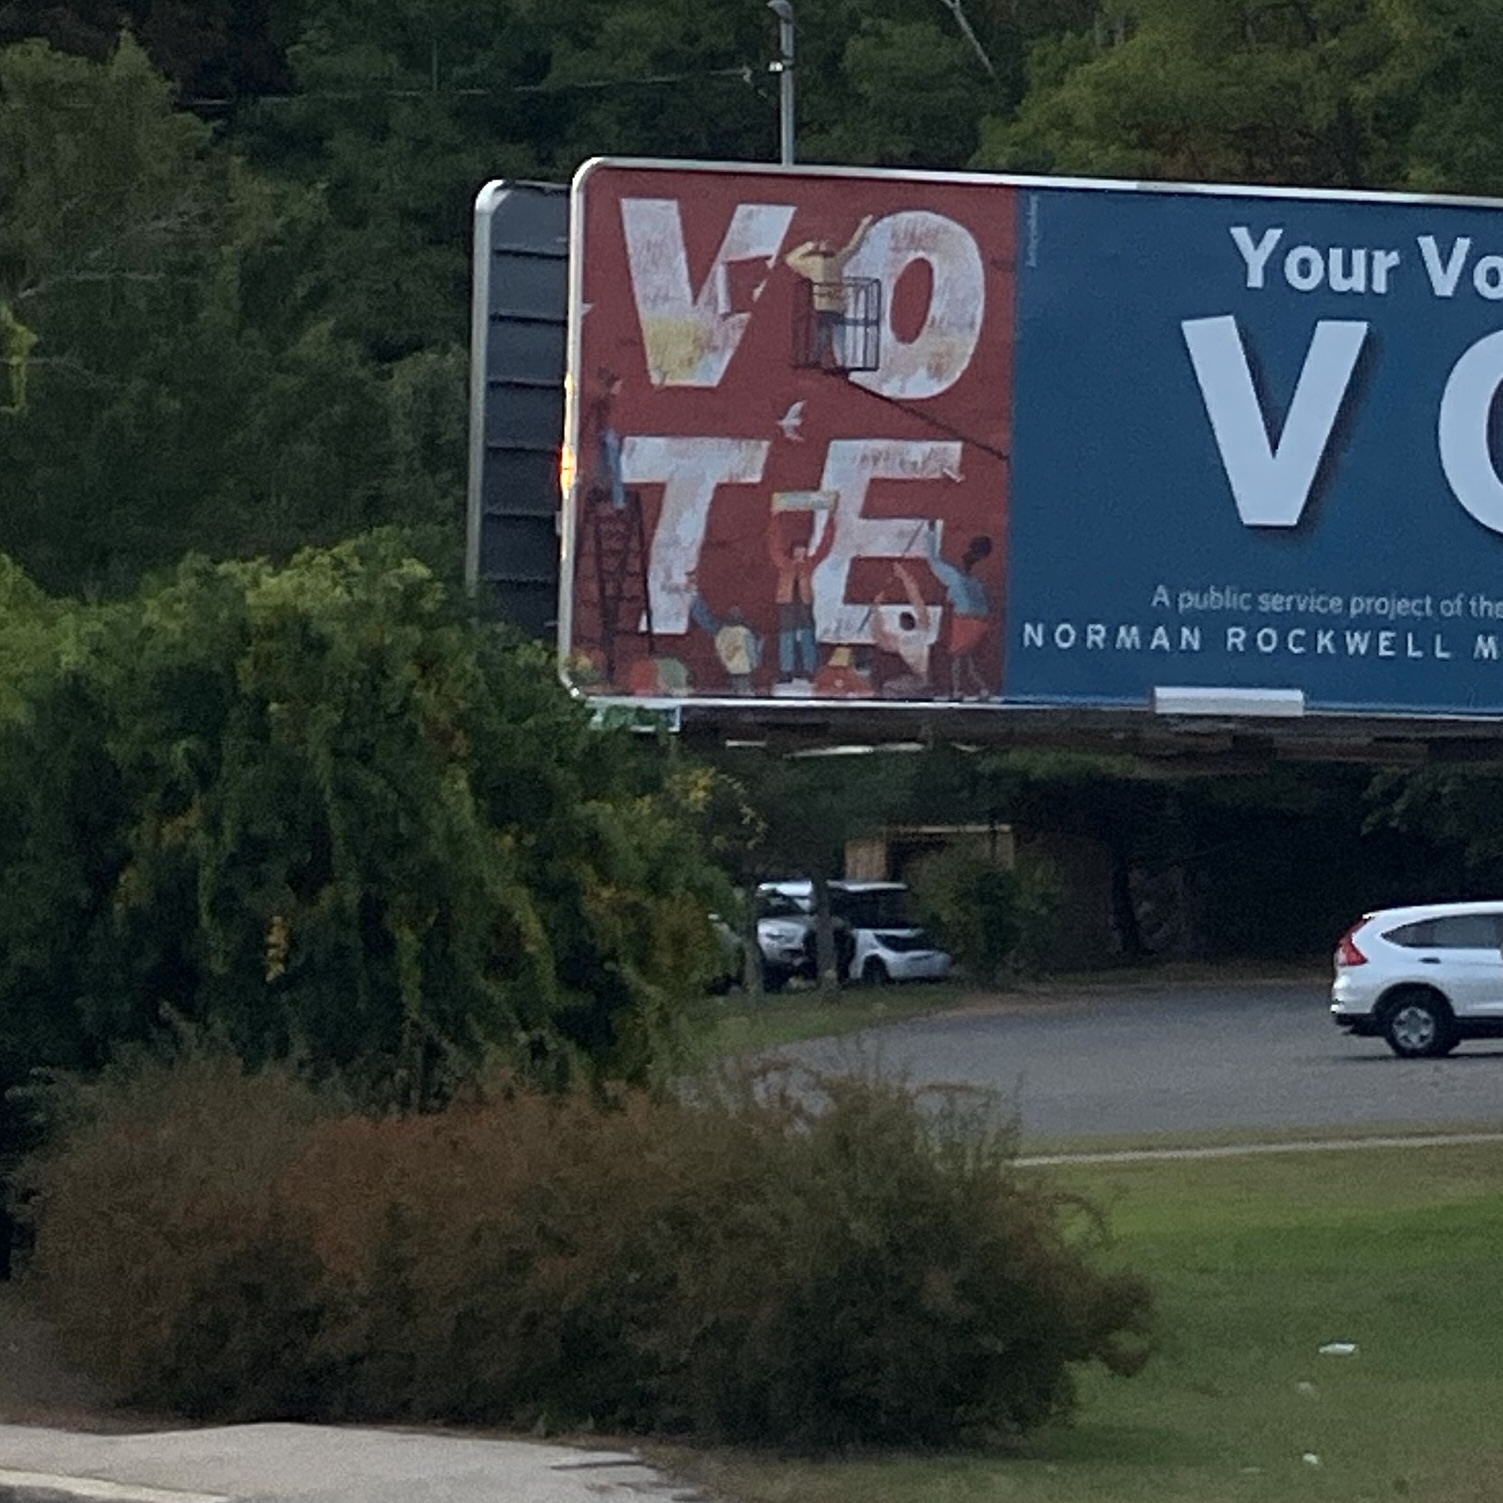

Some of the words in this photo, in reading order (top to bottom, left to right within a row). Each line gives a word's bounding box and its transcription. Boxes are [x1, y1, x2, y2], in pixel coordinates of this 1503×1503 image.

[1230, 226, 1401, 294] Your
[1151, 583, 1171, 607] A
[1177, 584, 1252, 615] public
[1257, 591, 1344, 615] service
[1349, 593, 1433, 621] project
[1440, 593, 1464, 618] of
[1023, 622, 1200, 652] NORMAN
[1226, 626, 1450, 659] ROCKWELL
